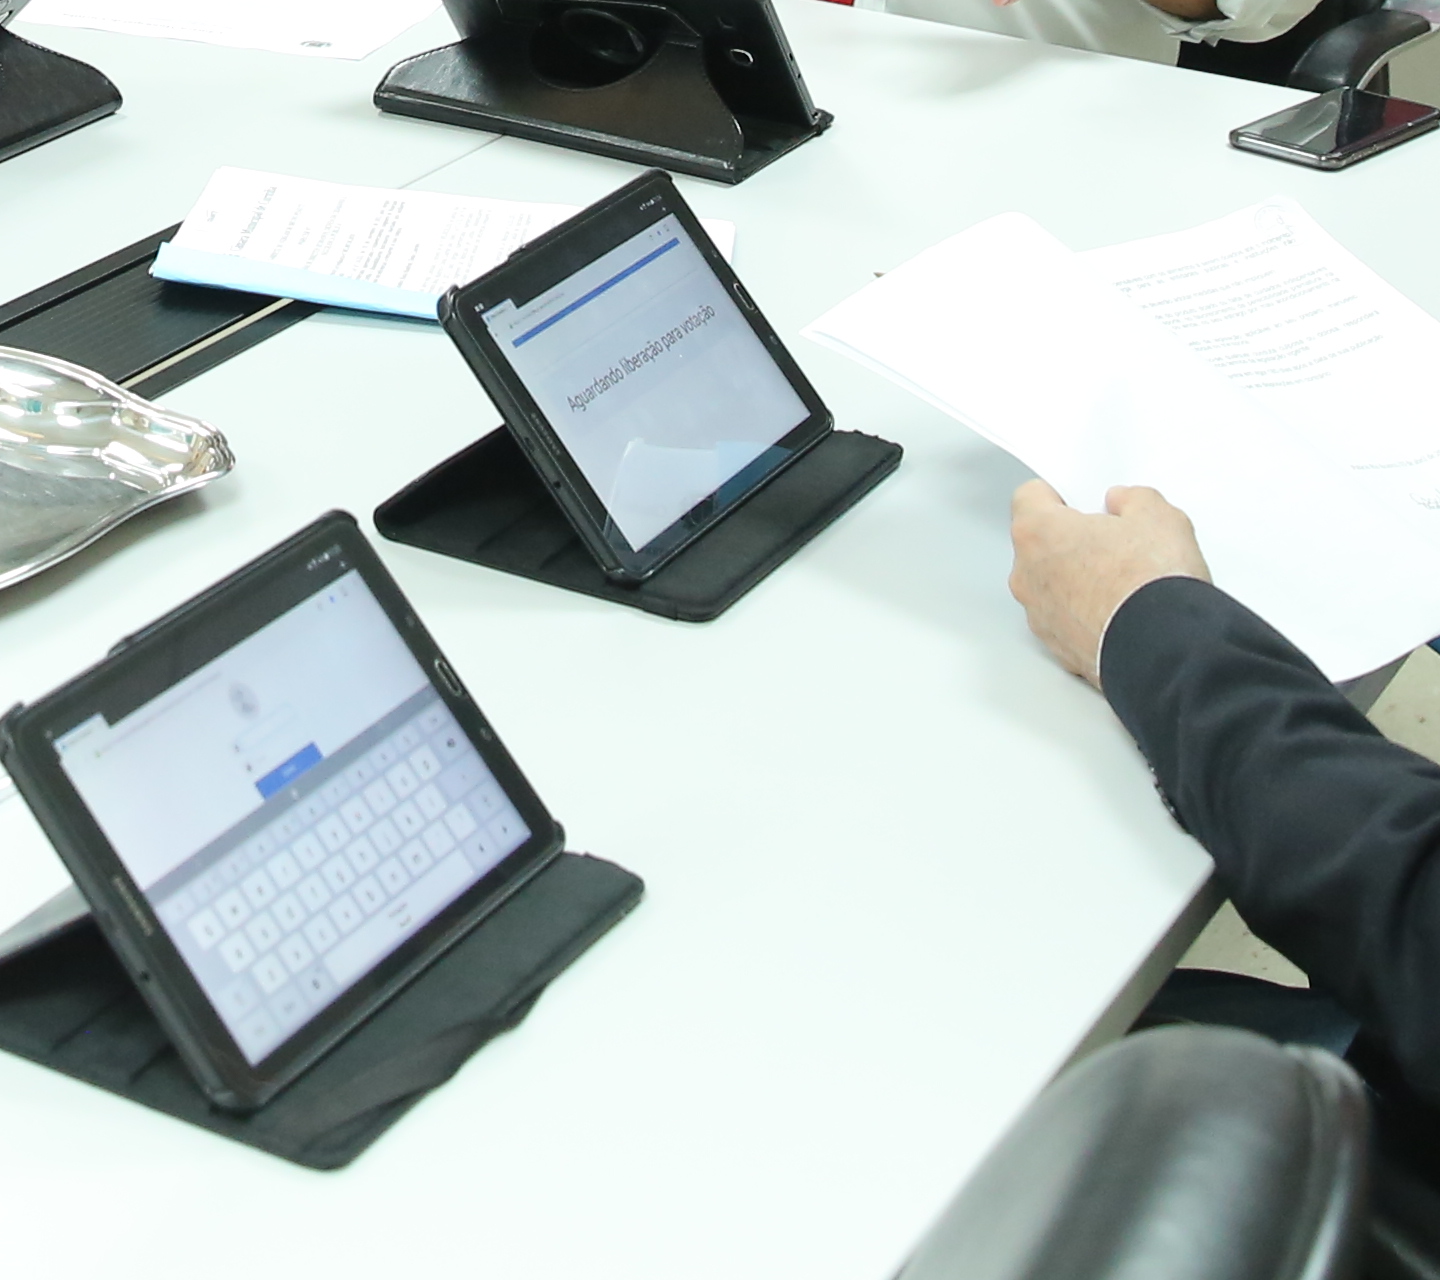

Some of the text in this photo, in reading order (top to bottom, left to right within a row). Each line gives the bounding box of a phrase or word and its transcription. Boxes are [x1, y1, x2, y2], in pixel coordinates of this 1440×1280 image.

[566, 303, 716, 413] Aguardando liberação para votação
